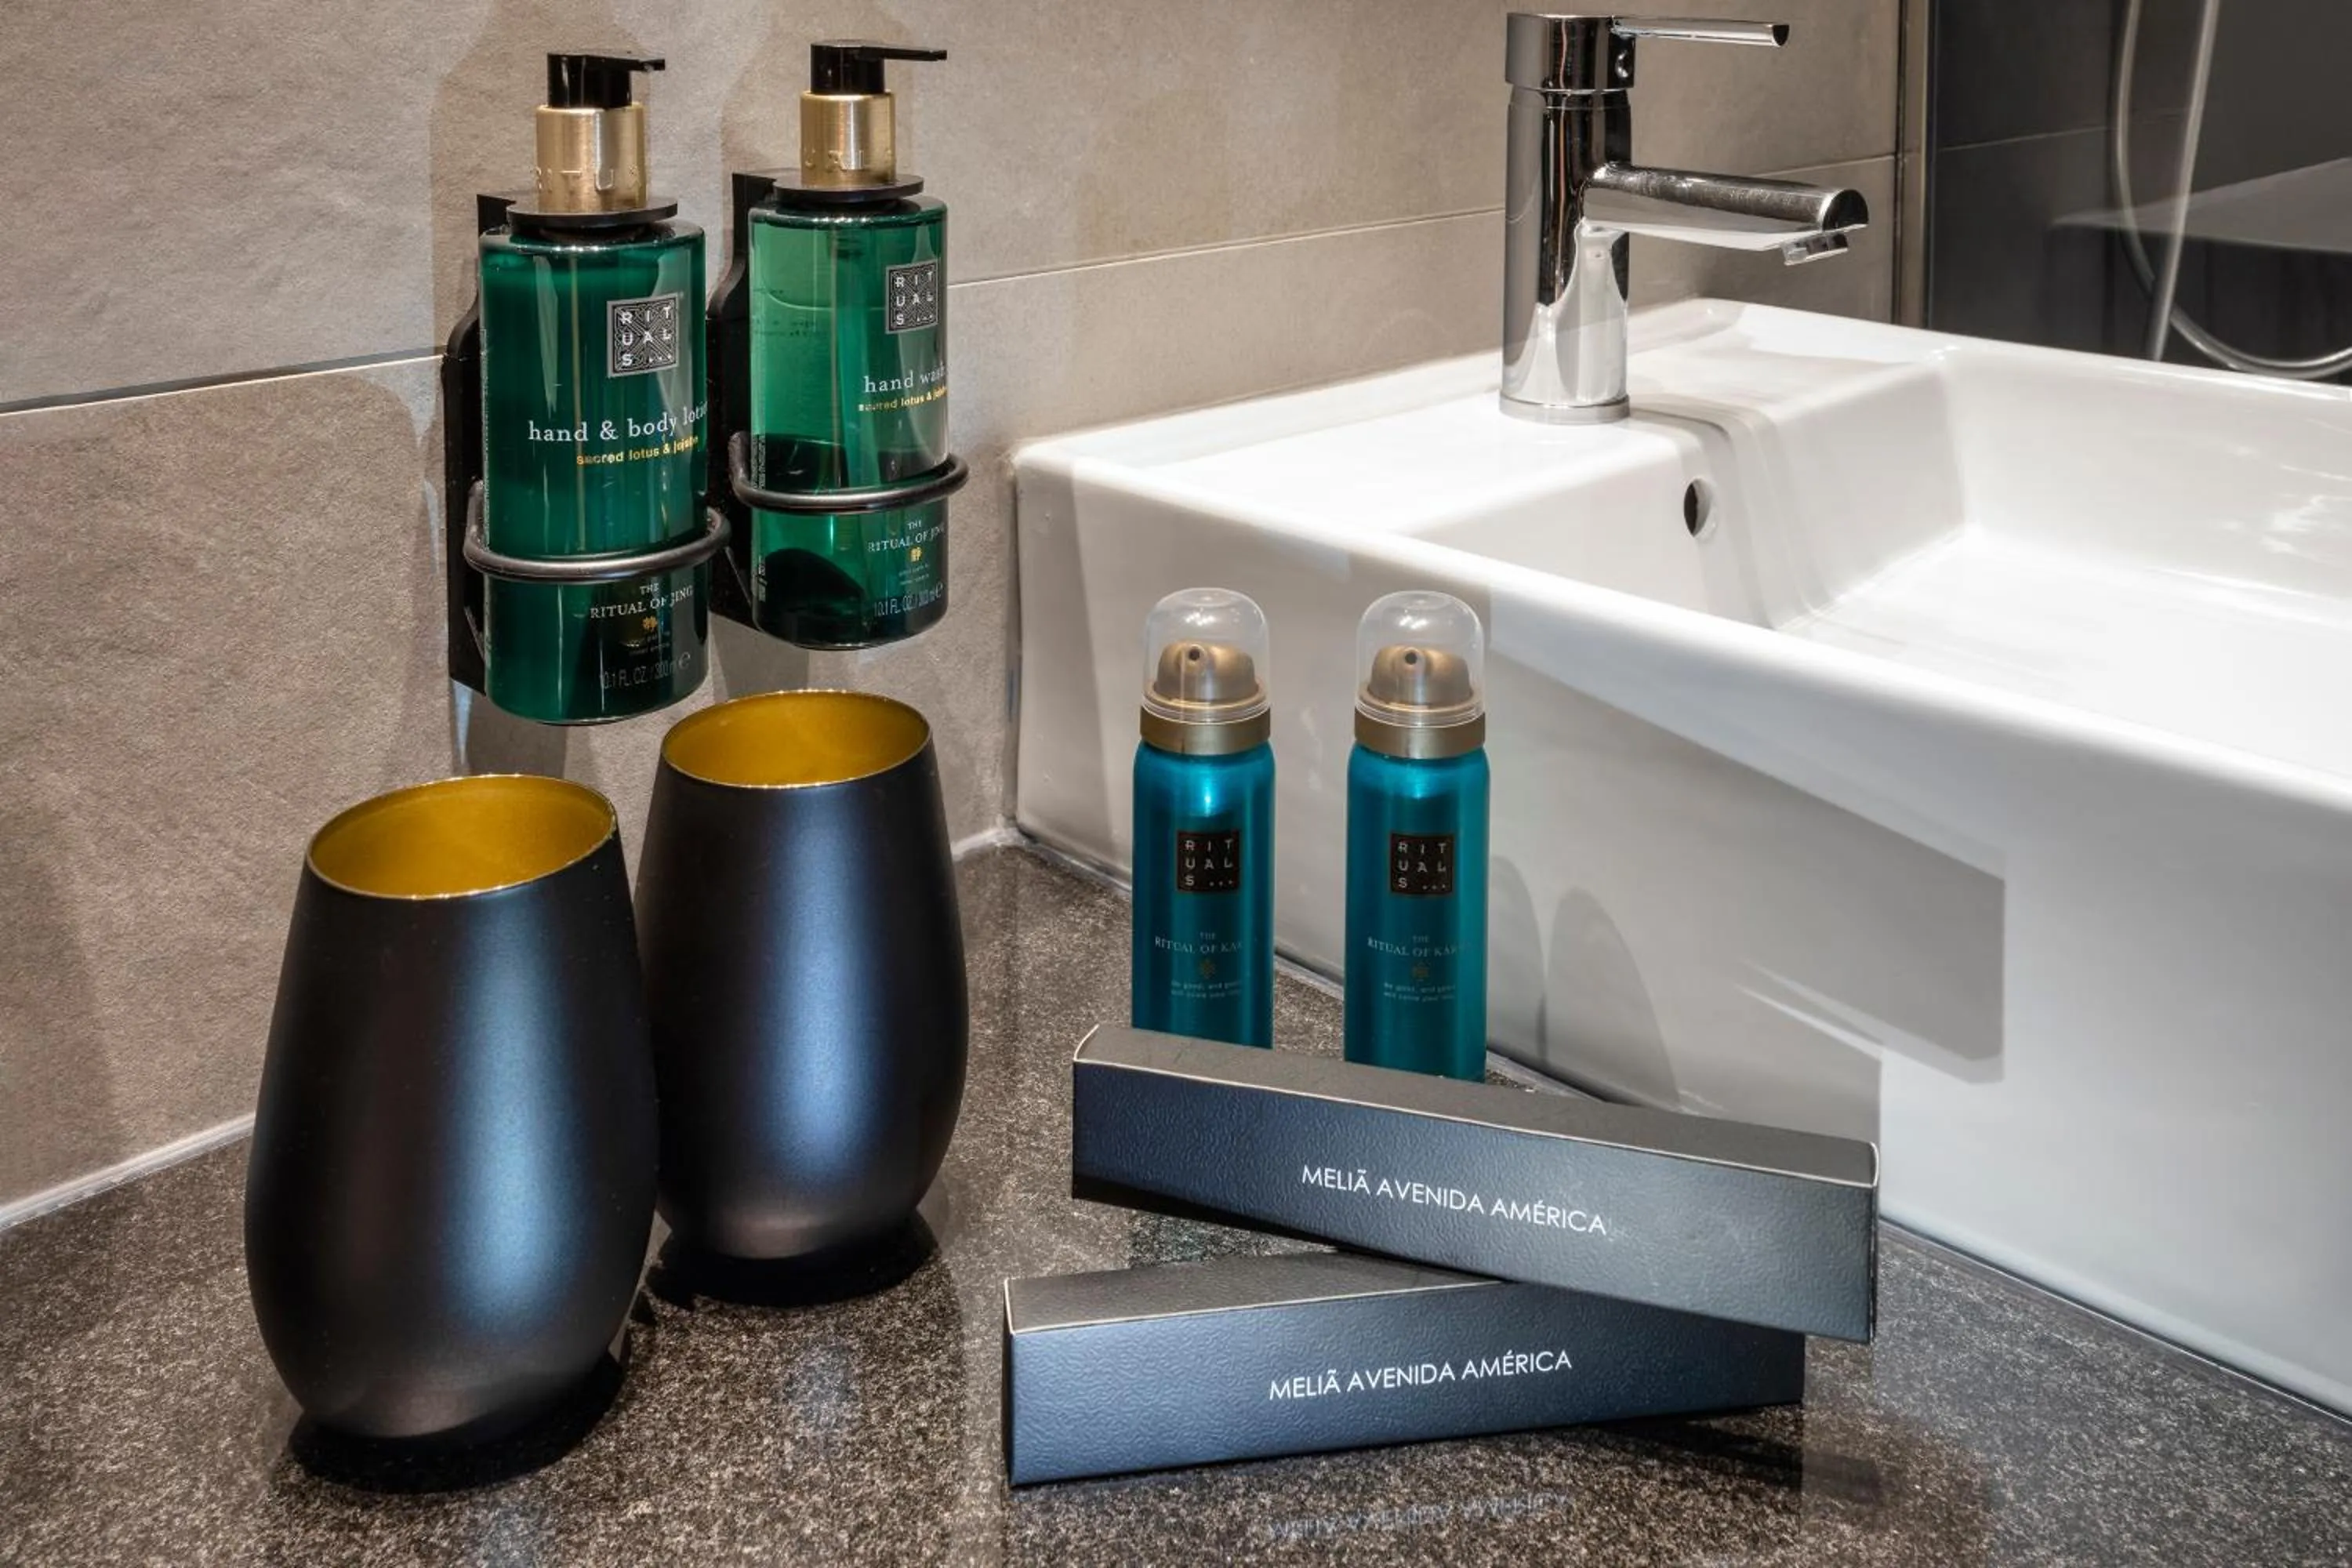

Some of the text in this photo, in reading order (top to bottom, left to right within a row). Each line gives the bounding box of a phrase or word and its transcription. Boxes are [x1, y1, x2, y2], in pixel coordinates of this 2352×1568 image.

[863, 369, 914, 393] hand
[528, 419, 589, 442] hand
[599, 419, 619, 440] &
[627, 412, 677, 437] body
[629, 448, 659, 460] lotus
[867, 535, 913, 553] RITUAL
[590, 601, 647, 619] RITUAL
[1376, 1178, 1485, 1214] AVENIDA
[1490, 1198, 1607, 1236] AMÉRICA
[1346, 1360, 1456, 1392] AVENIDA
[1461, 1349, 1573, 1381] AMÉRICA
